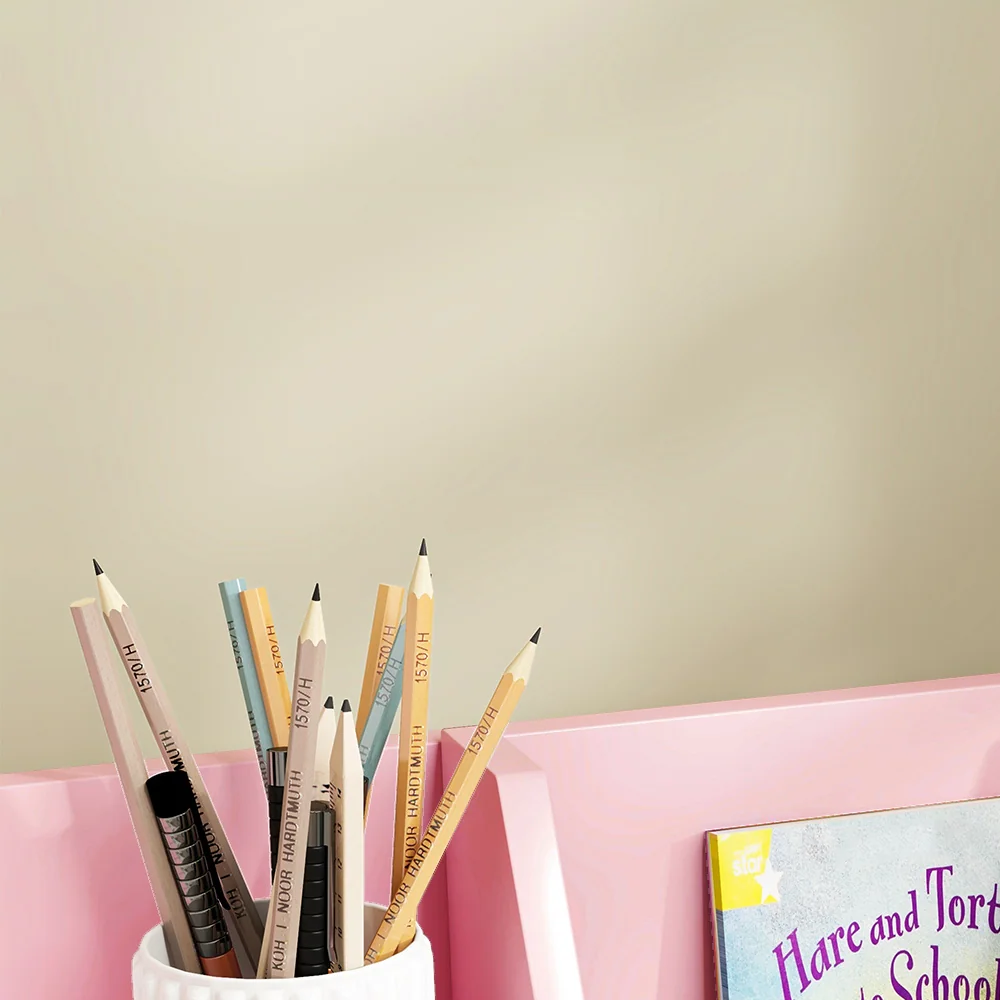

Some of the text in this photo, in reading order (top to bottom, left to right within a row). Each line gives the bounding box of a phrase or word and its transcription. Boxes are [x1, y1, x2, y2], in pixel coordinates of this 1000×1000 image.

[123, 643, 152, 693] 1570/H
[266, 625, 284, 675] 1570/H
[294, 677, 313, 729] 1570/H
[375, 657, 402, 708] 1570/H
[407, 725, 423, 818] HARDTMUTH
[415, 632, 430, 683] 1570/H
[282, 770, 301, 862] HARDTMUTH
[384, 882, 410, 924] NOOR
[407, 791, 456, 878] HARDTMUTH
[467, 706, 499, 756] 1570/H
[277, 869, 292, 913] NOOR
[870, 890, 920, 946] and
[272, 940, 285, 971] KOH
